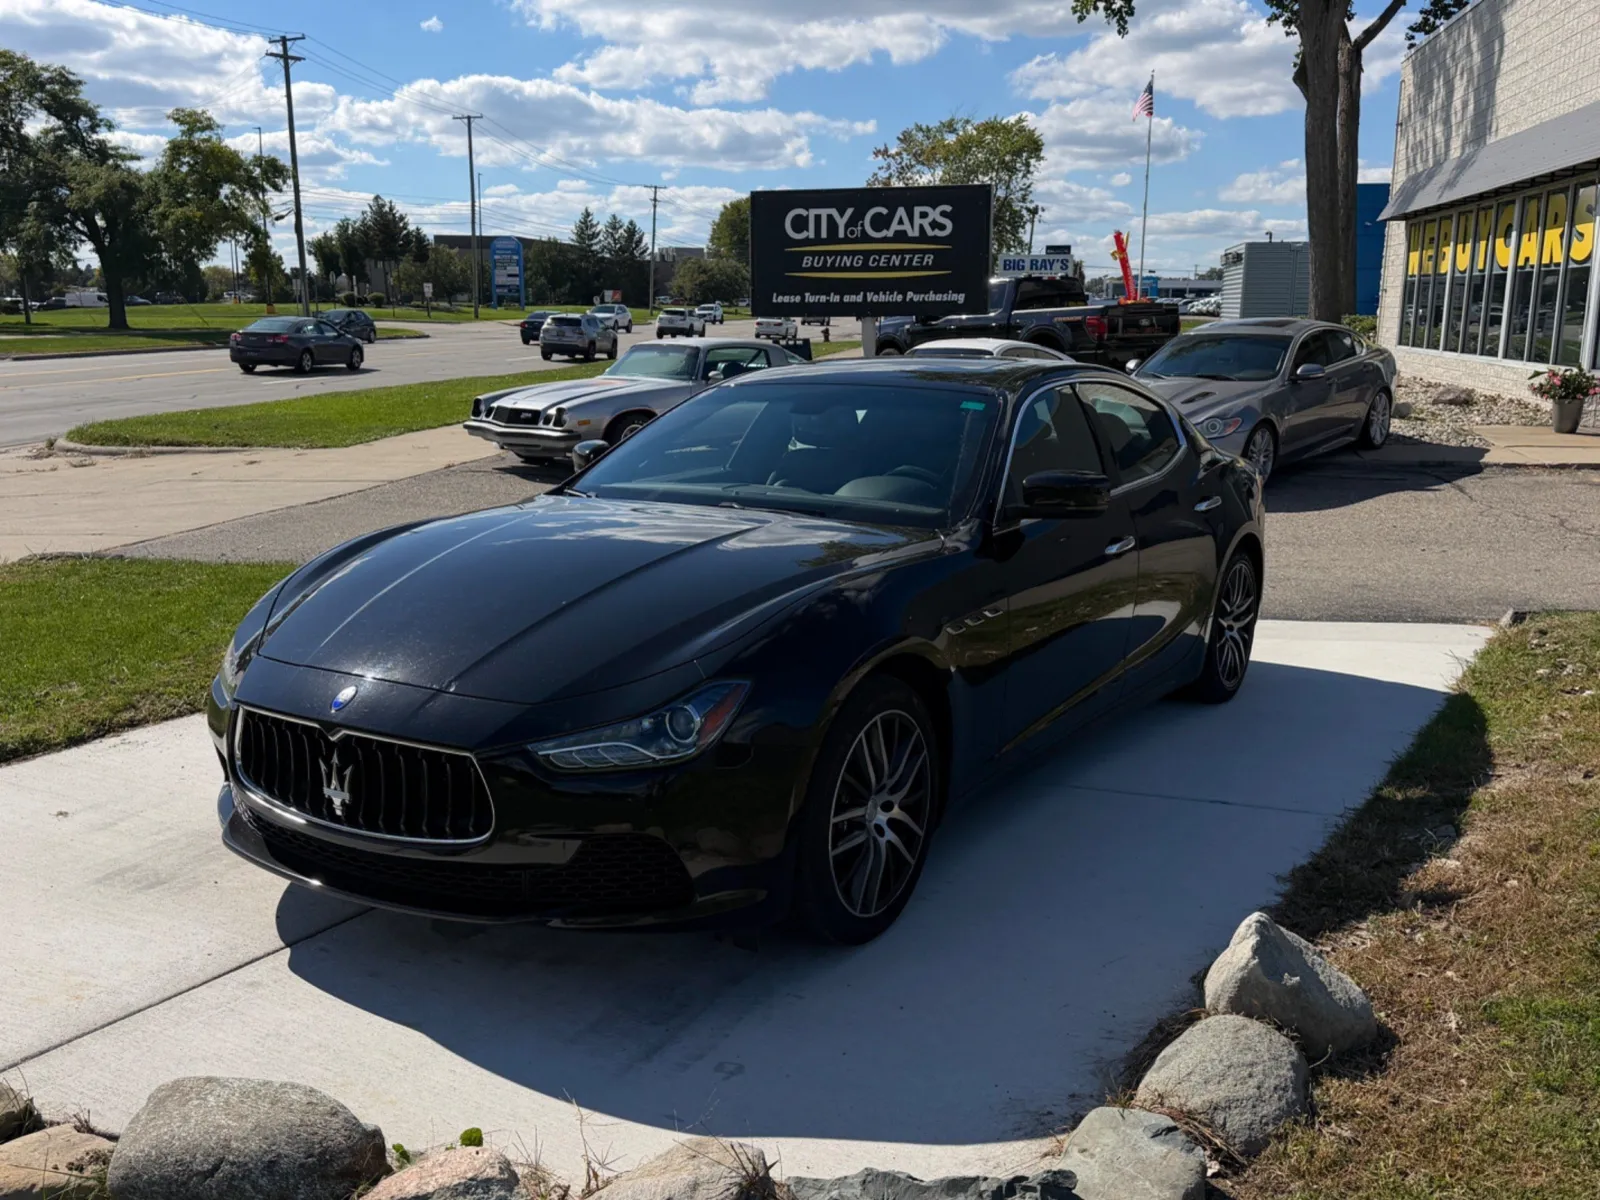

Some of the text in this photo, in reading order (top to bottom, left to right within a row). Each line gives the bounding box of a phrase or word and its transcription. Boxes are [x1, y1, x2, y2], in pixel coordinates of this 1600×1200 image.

[784, 204, 953, 240] CITY of CARS
[1495, 185, 1596, 269] CARS
[802, 254, 934, 268] BUYING CENTER
[1003, 258, 1069, 271] BIG RAY'S
[772, 290, 965, 305] Lease Turn-In and Vehicle Purchasing
